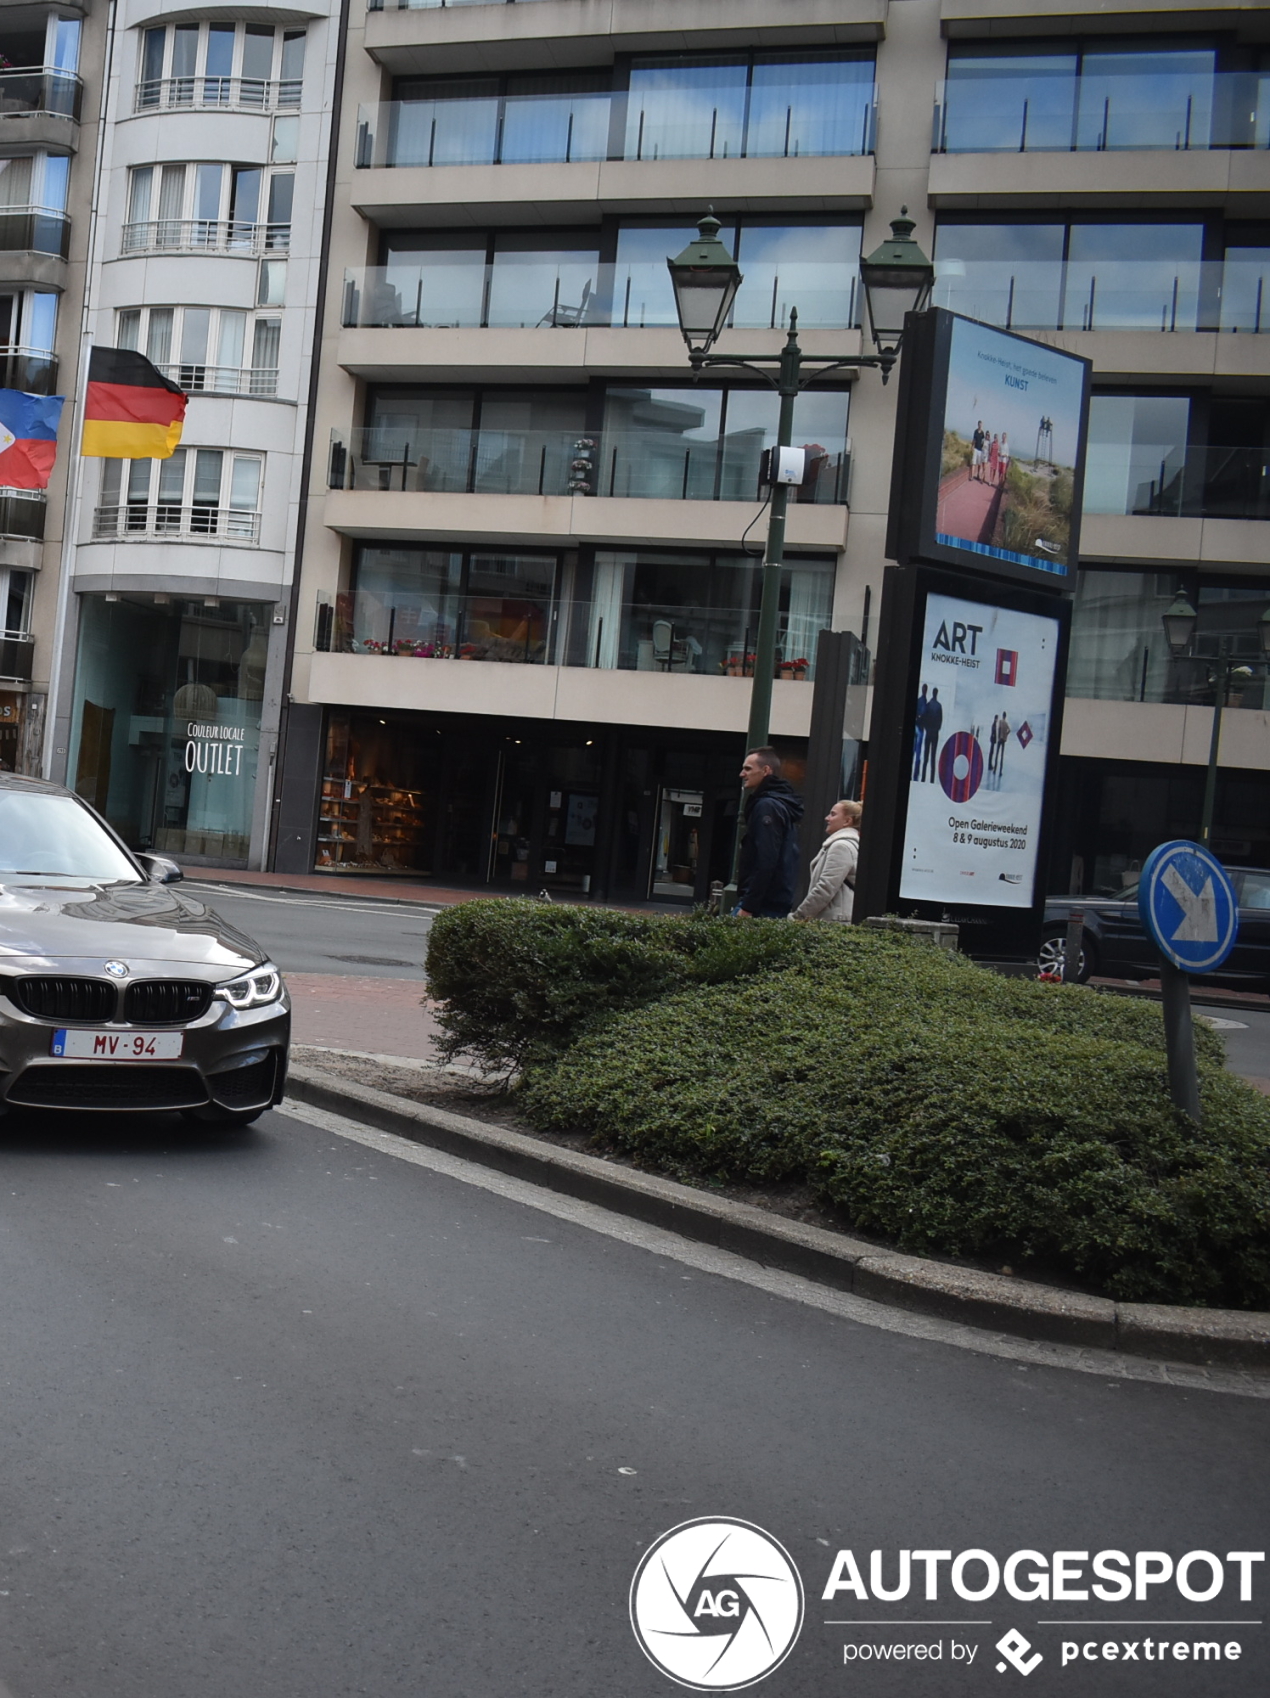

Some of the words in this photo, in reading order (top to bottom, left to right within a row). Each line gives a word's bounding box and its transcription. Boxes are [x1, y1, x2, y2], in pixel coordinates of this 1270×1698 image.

[1004, 374, 1029, 391] KUNST
[932, 619, 983, 656] ART
[931, 652, 981, 669] KNOKKE-HEIST
[219, 725, 245, 741] LOCALE
[185, 740, 244, 776] OUTLET
[948, 816, 969, 831] Open
[970, 819, 1028, 836] Galerieweekend
[953, 832, 958, 843] 8
[959, 833, 966, 844] &
[967, 833, 973, 844] 9
[973, 837, 1009, 850] augustus
[1009, 838, 1027, 850] 2020
[54, 1044, 63, 1054] B
